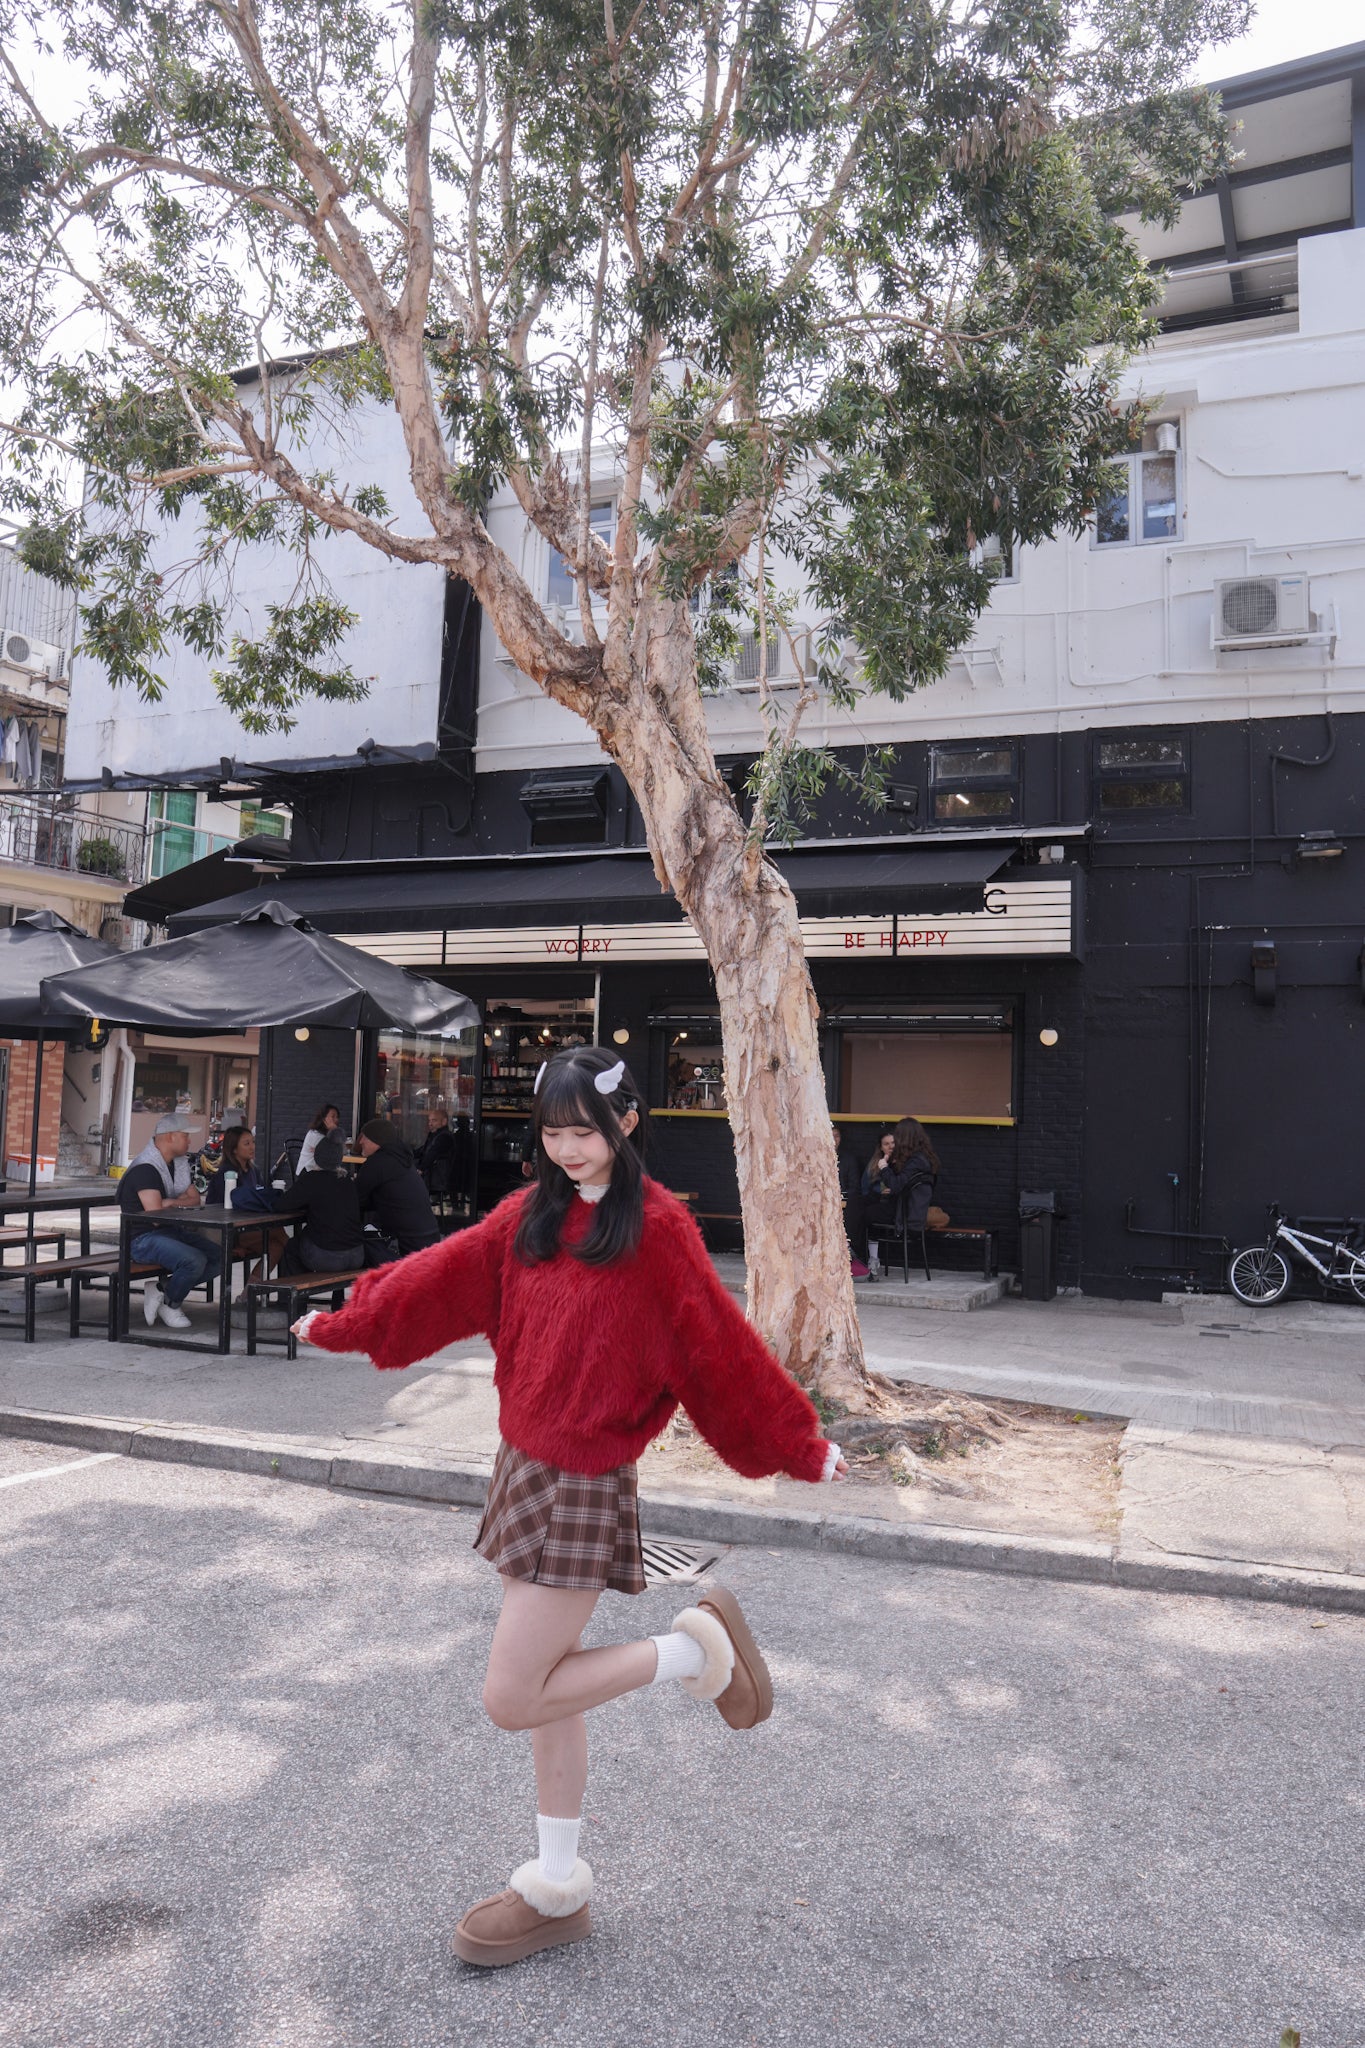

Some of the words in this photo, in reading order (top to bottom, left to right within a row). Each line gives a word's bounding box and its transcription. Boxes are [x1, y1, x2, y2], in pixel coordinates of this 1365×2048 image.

[545, 939, 611, 954] WORRY
[844, 932, 866, 949] BE
[880, 931, 948, 948] HAPPY
